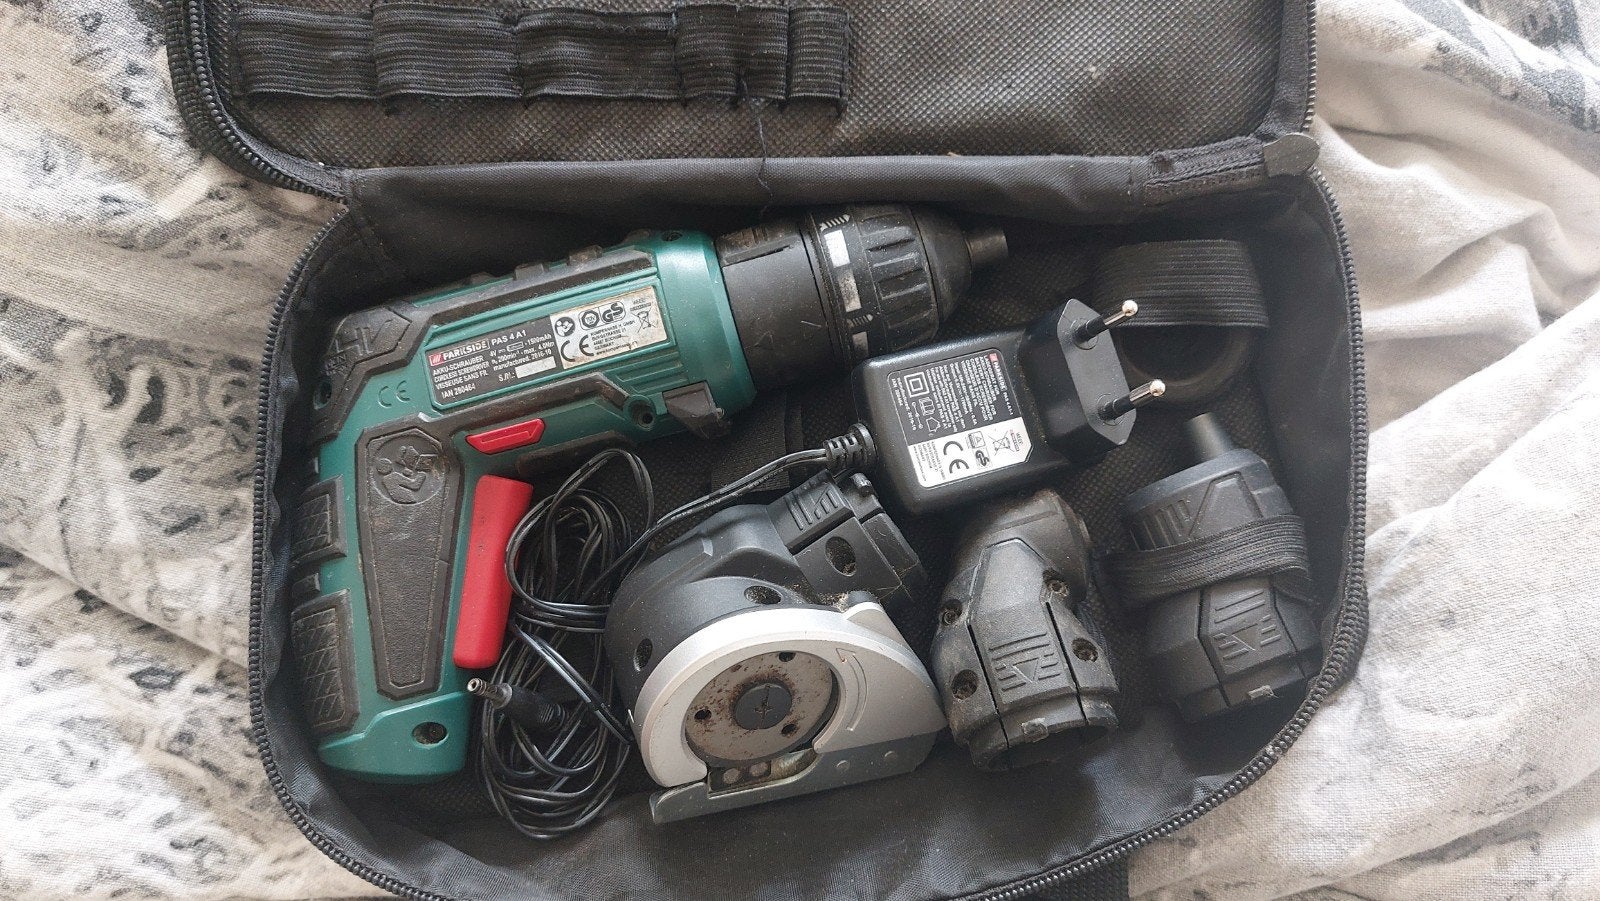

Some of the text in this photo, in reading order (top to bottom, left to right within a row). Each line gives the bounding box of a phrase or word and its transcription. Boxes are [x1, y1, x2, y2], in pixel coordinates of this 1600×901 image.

[443, 341, 487, 360] PARKSIDE
[491, 336, 508, 346] PAS
[516, 330, 527, 338] A1
[432, 355, 484, 376] AKKU-SCHRAUBER
[434, 361, 490, 383] CORDLESS SCREWDRIVER
[993, 361, 1006, 389] PARKSIDE
[436, 377, 463, 390] VISSEUSE
[463, 372, 479, 382] SANS
[442, 389, 454, 399] IAN
